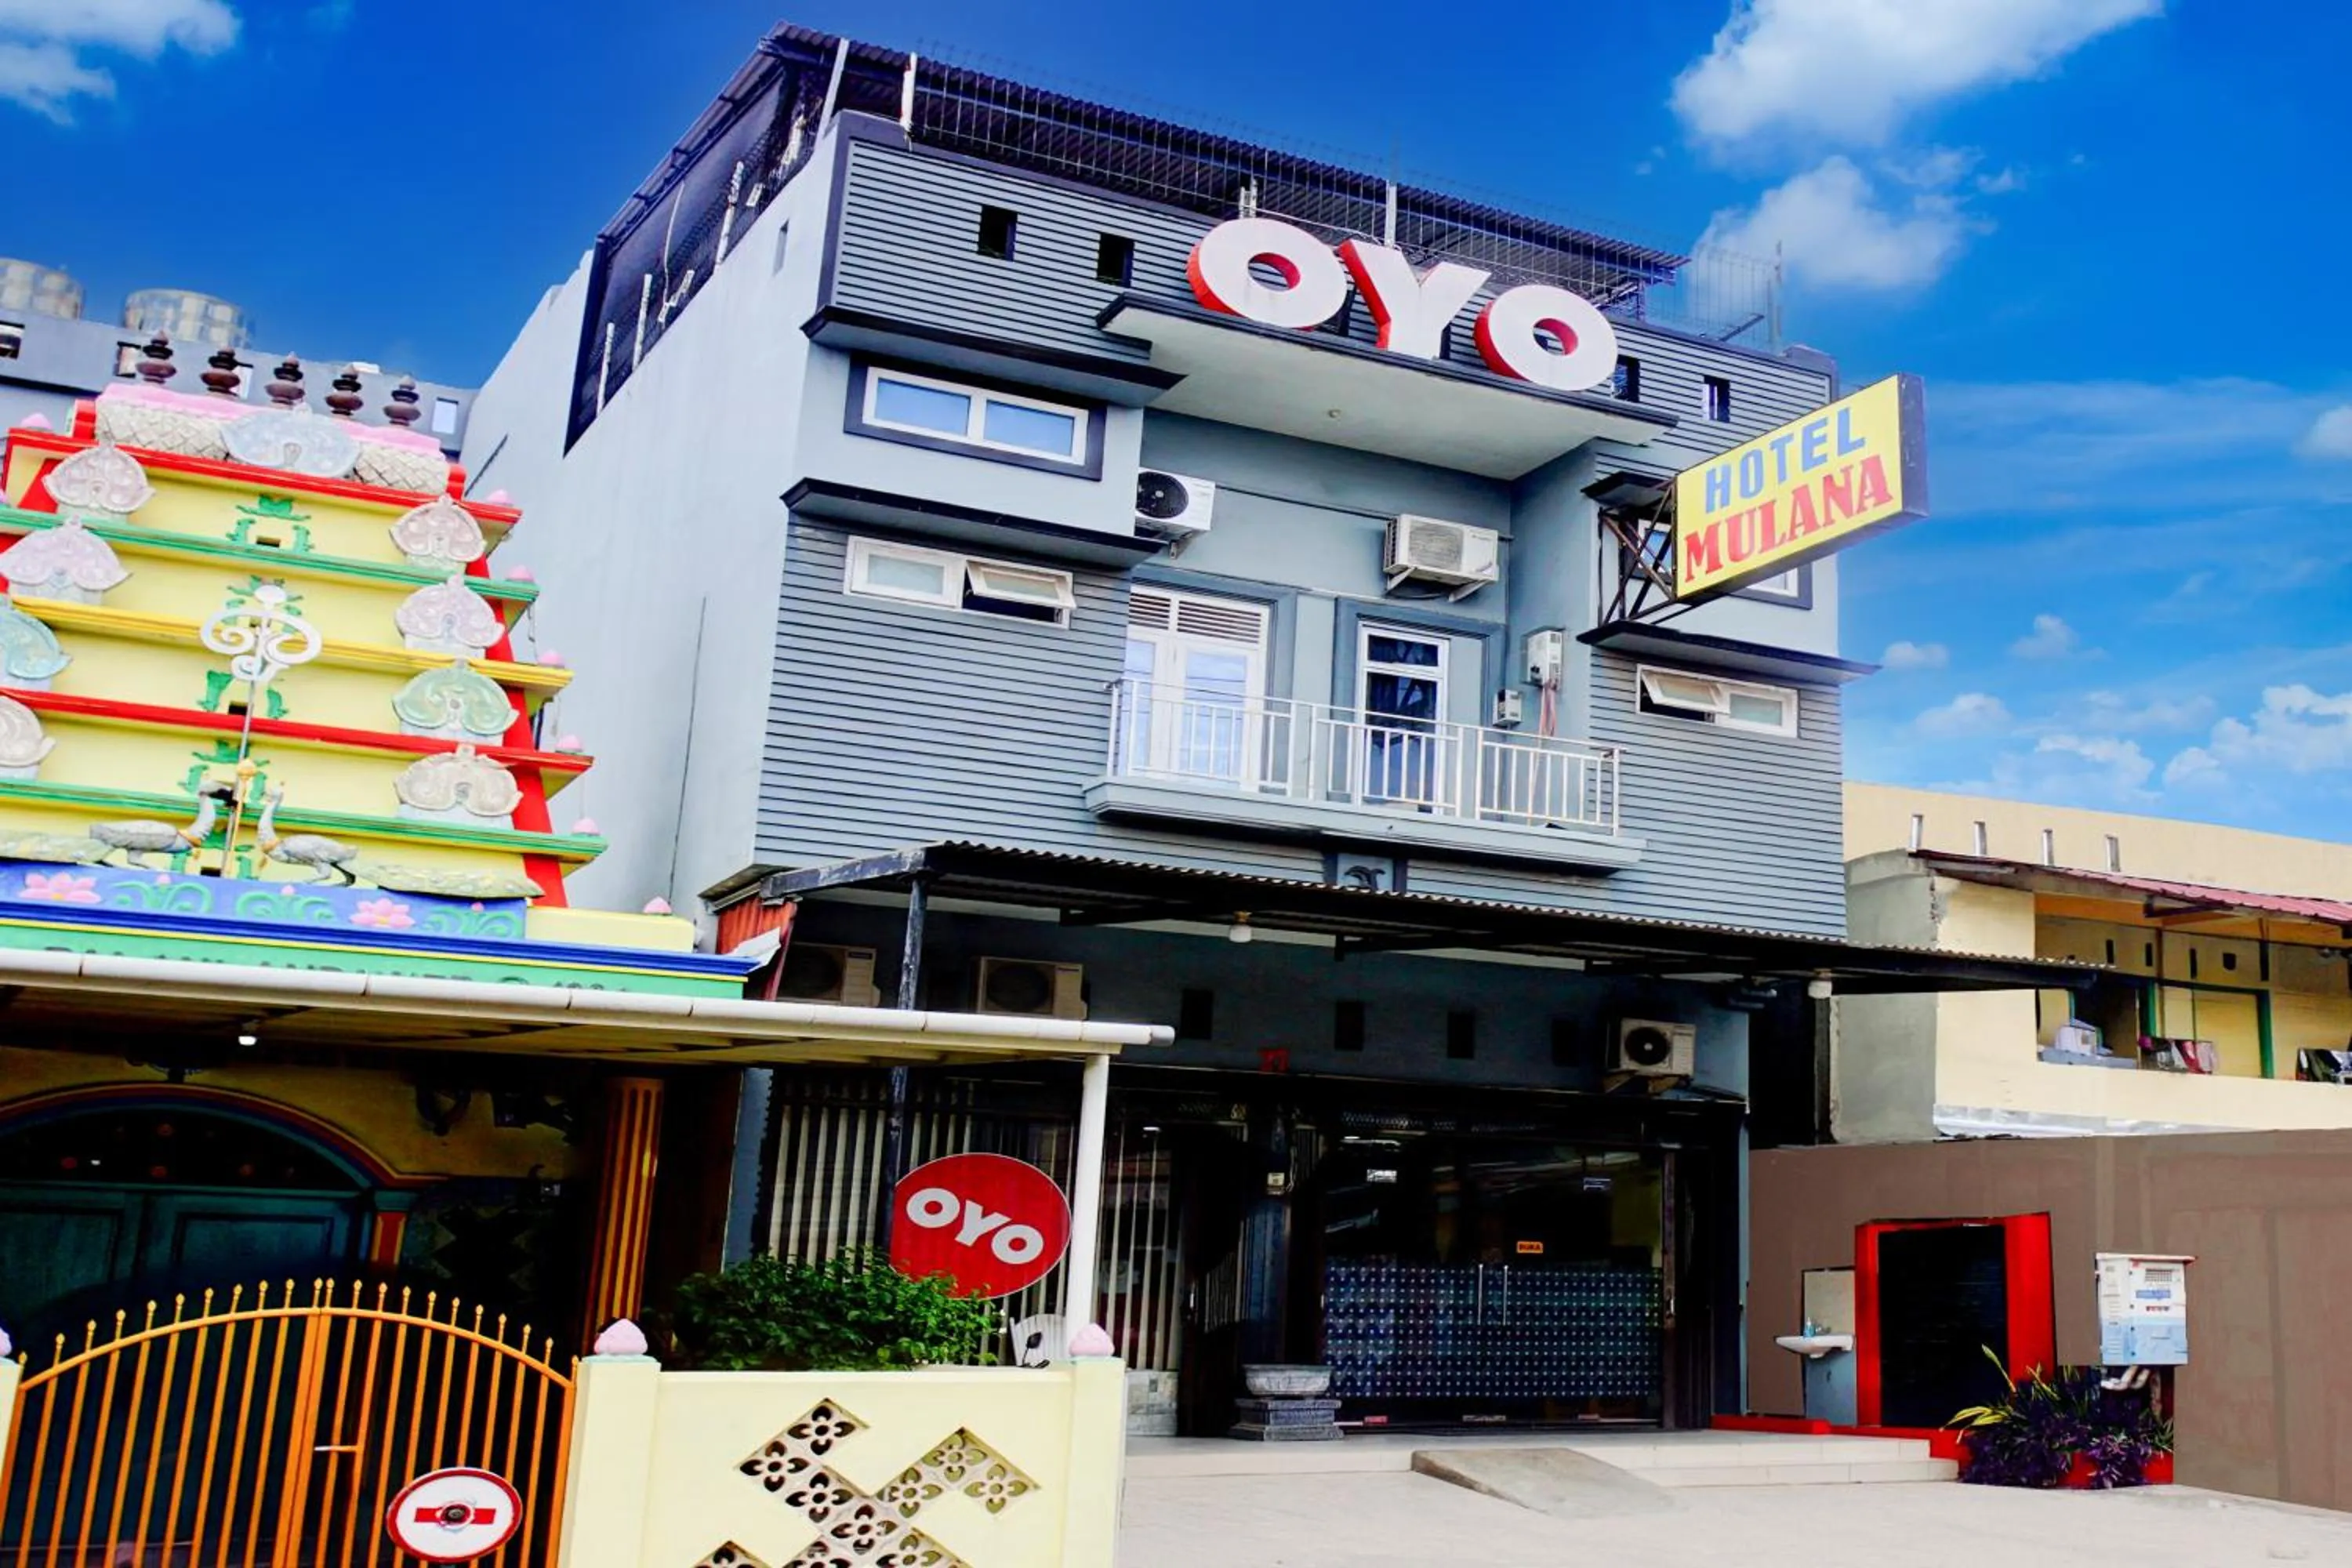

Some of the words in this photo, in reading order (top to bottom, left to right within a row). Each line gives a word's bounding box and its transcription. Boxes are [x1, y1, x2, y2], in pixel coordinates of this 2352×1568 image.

[1187, 218, 1618, 391] OYO
[1684, 454, 1893, 583] MULANA
[1704, 406, 1866, 514] HOTEL
[906, 1187, 1044, 1265] OYO
